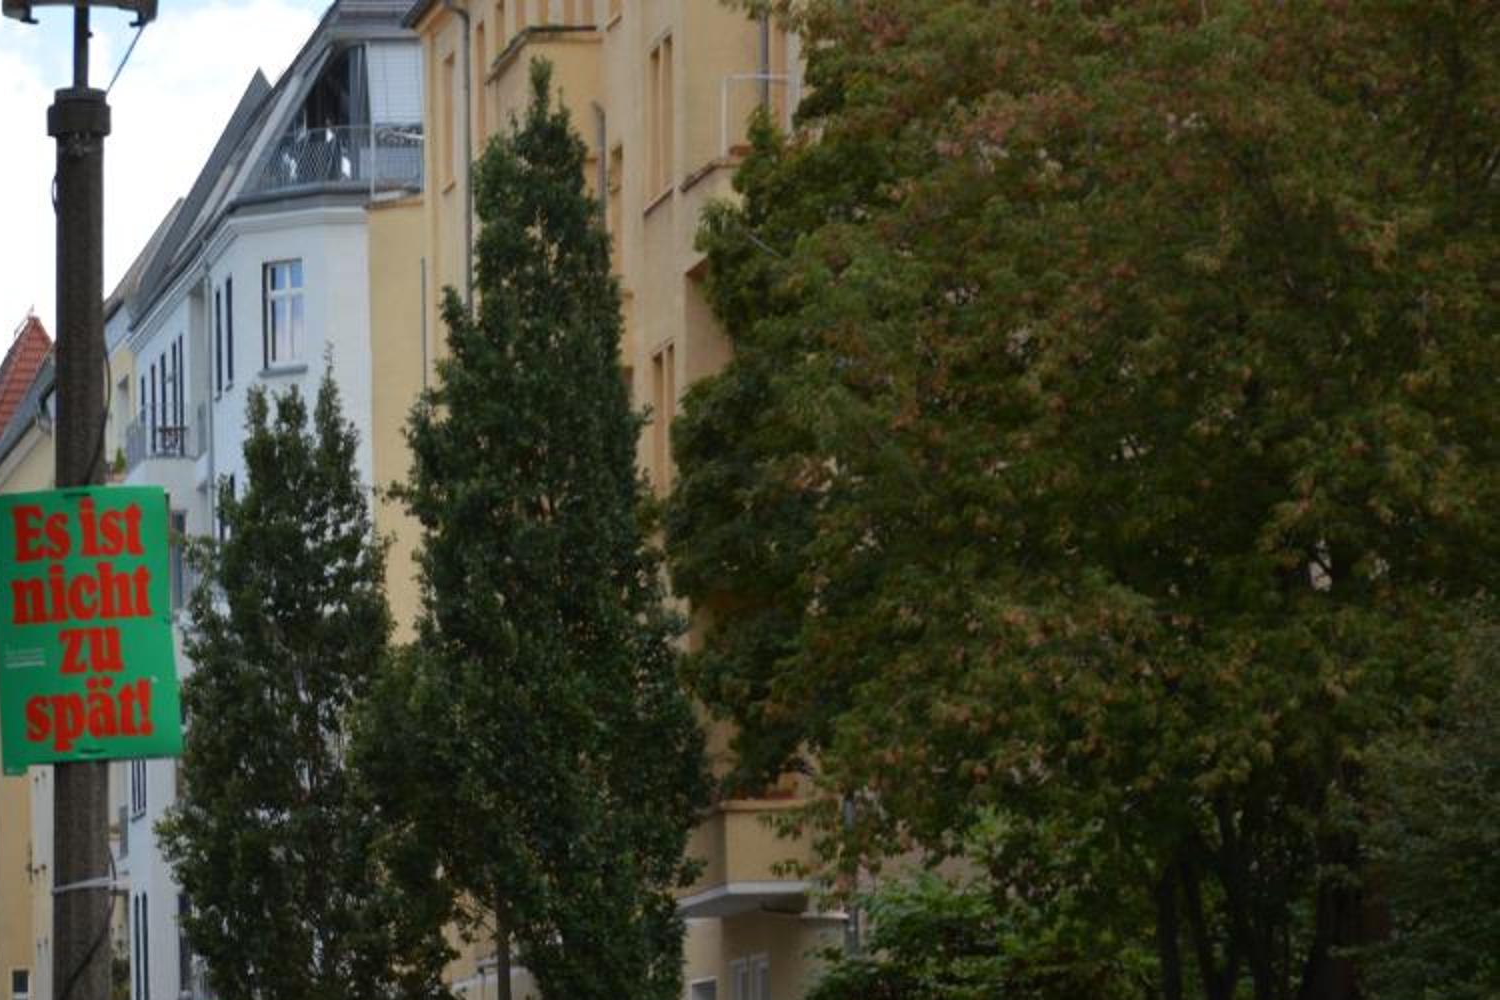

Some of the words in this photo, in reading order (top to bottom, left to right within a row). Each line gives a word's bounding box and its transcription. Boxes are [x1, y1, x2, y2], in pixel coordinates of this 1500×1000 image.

[11, 504, 71, 563] Es
[78, 496, 144, 557] ist
[10, 561, 153, 625] nicht
[59, 626, 124, 676] zu
[24, 676, 153, 752] spät!
